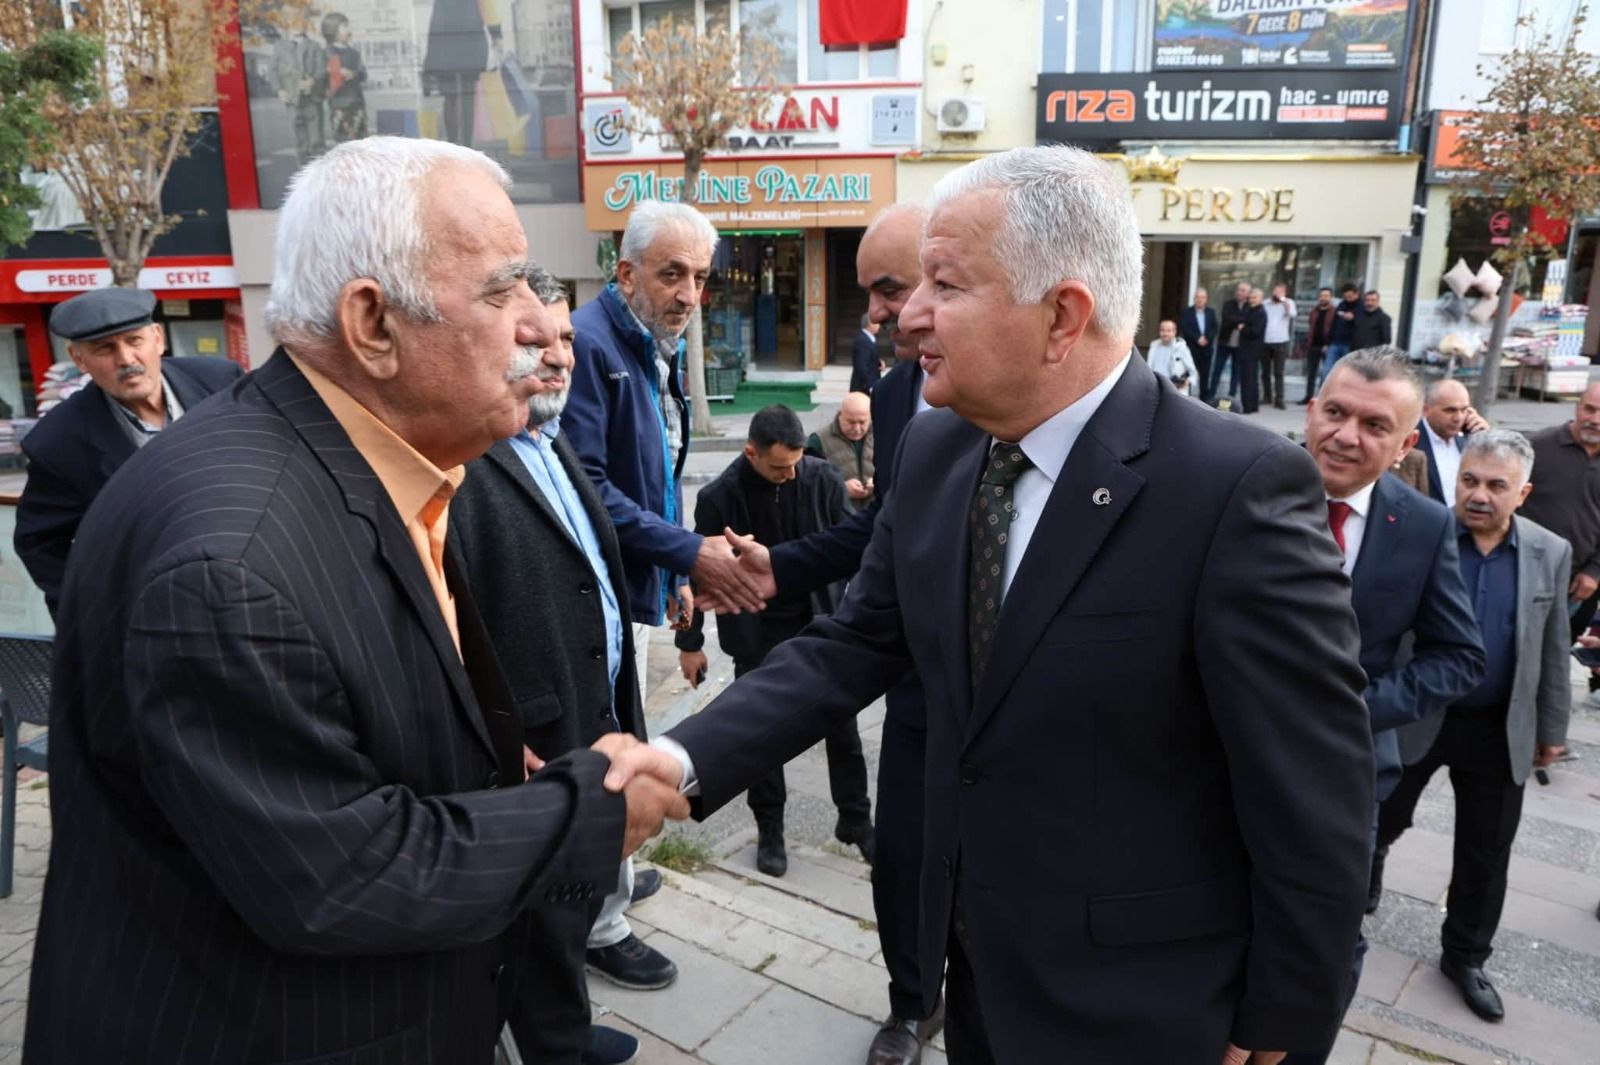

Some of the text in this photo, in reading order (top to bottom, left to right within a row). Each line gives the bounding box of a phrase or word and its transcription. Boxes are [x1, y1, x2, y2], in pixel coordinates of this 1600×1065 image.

[1246, 10, 1327, 35] 7 GECE 8 GÜN
[1144, 81, 1271, 121] turizm
[1280, 86, 1317, 105] hac
[1336, 89, 1389, 105] umre
[728, 136, 794, 150] SAAT
[756, 166, 872, 202] PAZARI
[1160, 187, 1295, 223] PERDE
[48, 274, 97, 286] PERDE
[166, 269, 210, 287] ÇEYİZ
